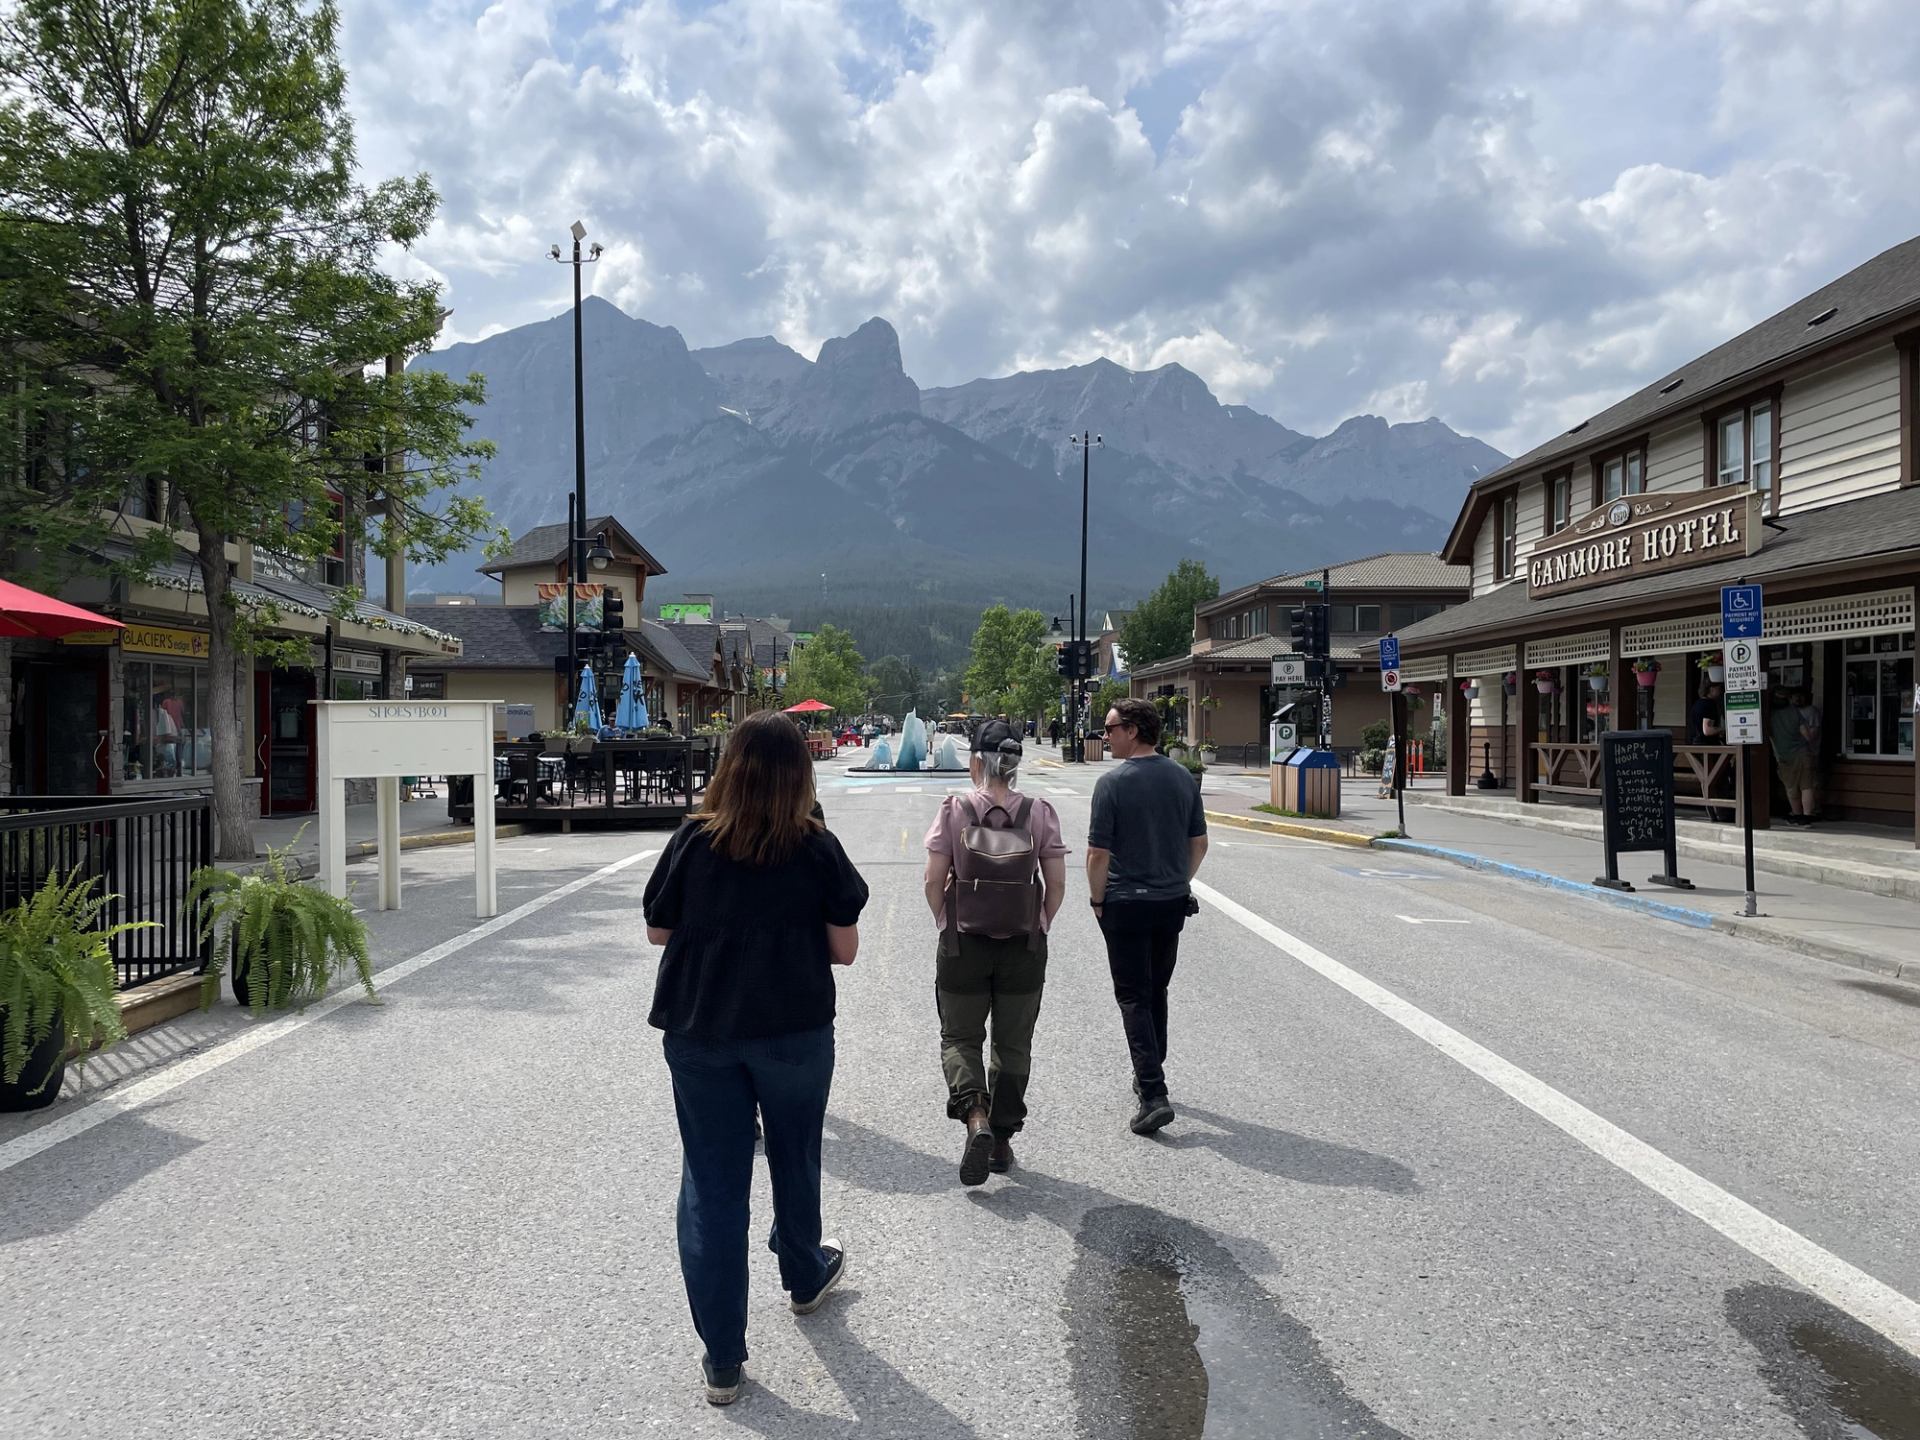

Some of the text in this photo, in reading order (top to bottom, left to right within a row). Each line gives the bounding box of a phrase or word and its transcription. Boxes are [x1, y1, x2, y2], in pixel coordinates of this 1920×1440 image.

[1531, 508, 1740, 588] CANMORE HOTEL
[122, 629, 173, 649] GLACIER'S
[1727, 671, 1757, 679] REQUIRED
[1728, 664, 1755, 673] PAYMENT
[1615, 752, 1639, 765] HOUR
